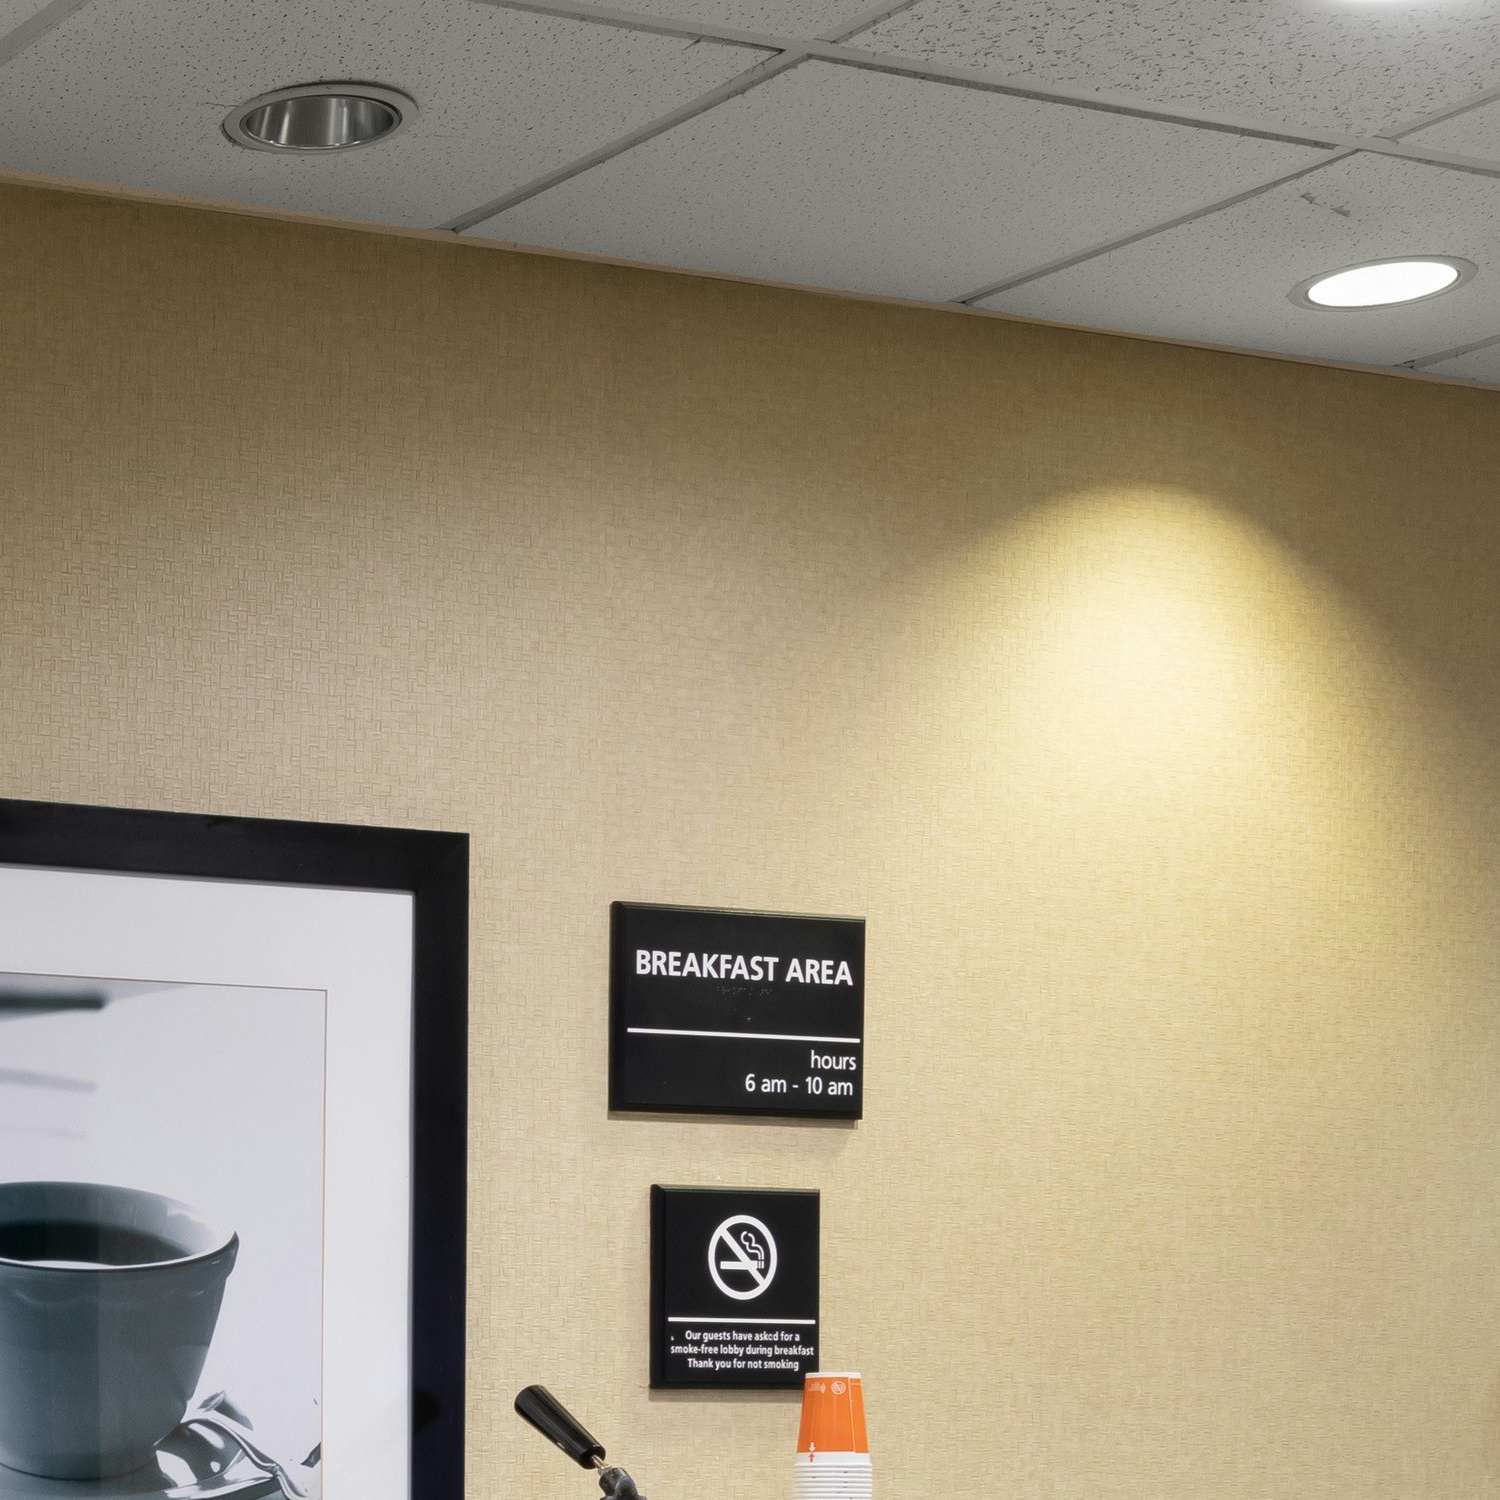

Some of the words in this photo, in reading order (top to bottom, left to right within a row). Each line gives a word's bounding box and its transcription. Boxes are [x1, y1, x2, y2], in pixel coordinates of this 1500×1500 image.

[635, 949, 780, 982] BREAKFAST
[784, 957, 854, 986] AREA
[810, 1049, 857, 1071] hours
[744, 1073, 756, 1092] 6
[760, 1078, 787, 1093] am
[805, 1076, 823, 1094] 10
[827, 1080, 853, 1096] am
[685, 1330, 701, 1341] Our
[702, 1331, 731, 1343] guests
[732, 1330, 753, 1341] have
[754, 1331, 779, 1341] asked
[780, 1331, 793, 1341] for
[794, 1333, 800, 1341] a
[670, 1344, 719, 1355] smoke-free
[720, 1344, 744, 1357] lobby
[746, 1345, 773, 1357] during
[774, 1345, 814, 1356] breakfast
[687, 1358, 714, 1369] Thank
[715, 1359, 732, 1371] you
[733, 1358, 746, 1369] for
[747, 1359, 762, 1369] not
[763, 1359, 800, 1372] smoking
